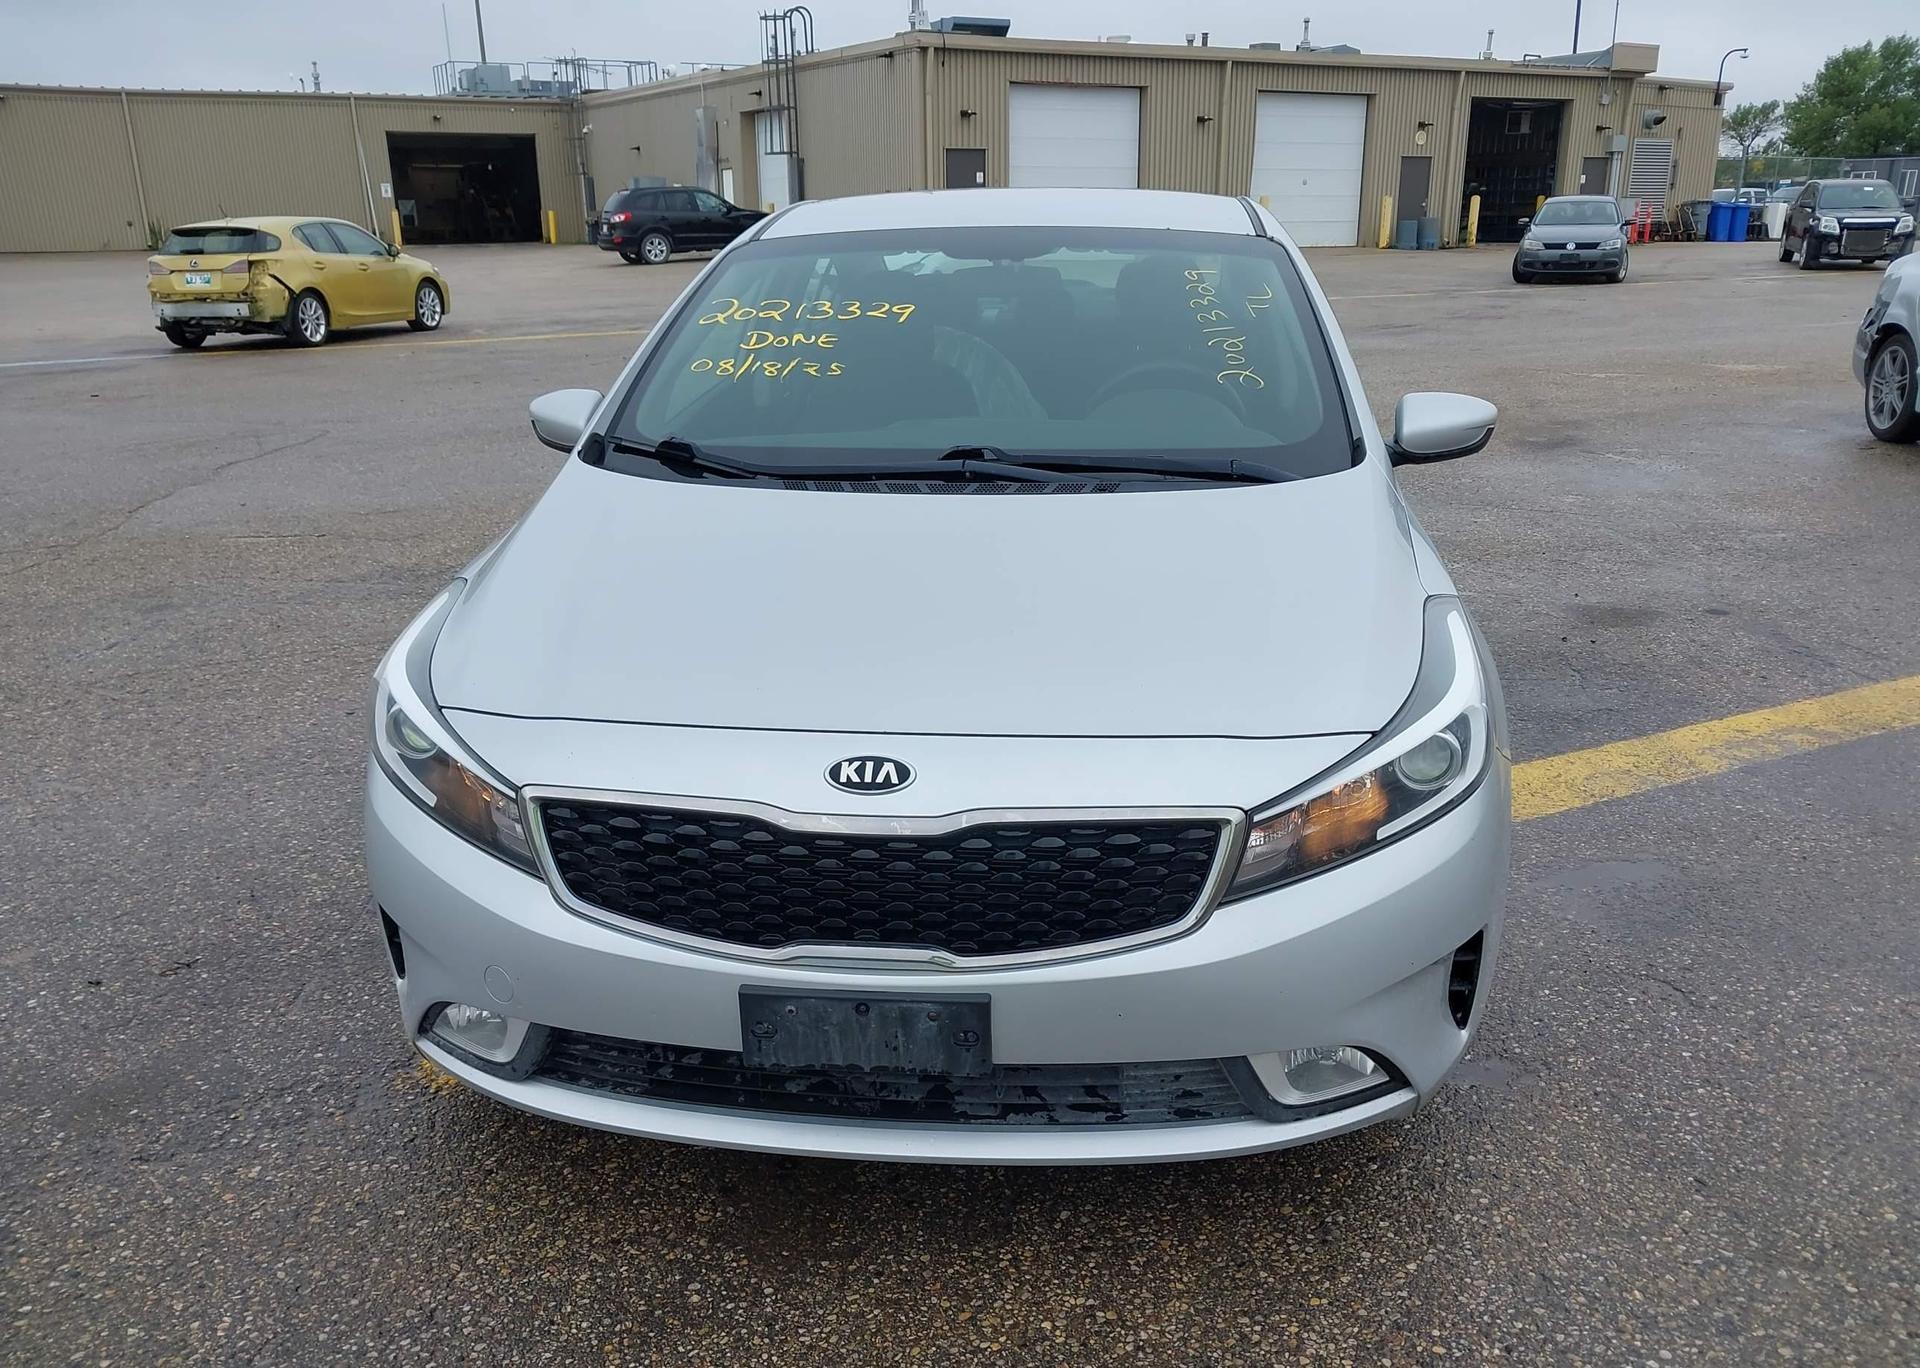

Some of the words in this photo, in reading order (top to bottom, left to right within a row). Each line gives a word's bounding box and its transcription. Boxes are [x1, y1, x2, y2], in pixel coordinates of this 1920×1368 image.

[698, 298, 917, 325] 20213329
[739, 330, 840, 350] DONE
[1183, 268, 1265, 390] 20213329
[690, 353, 846, 384] 08/18/25
[839, 760, 900, 785] KIA
